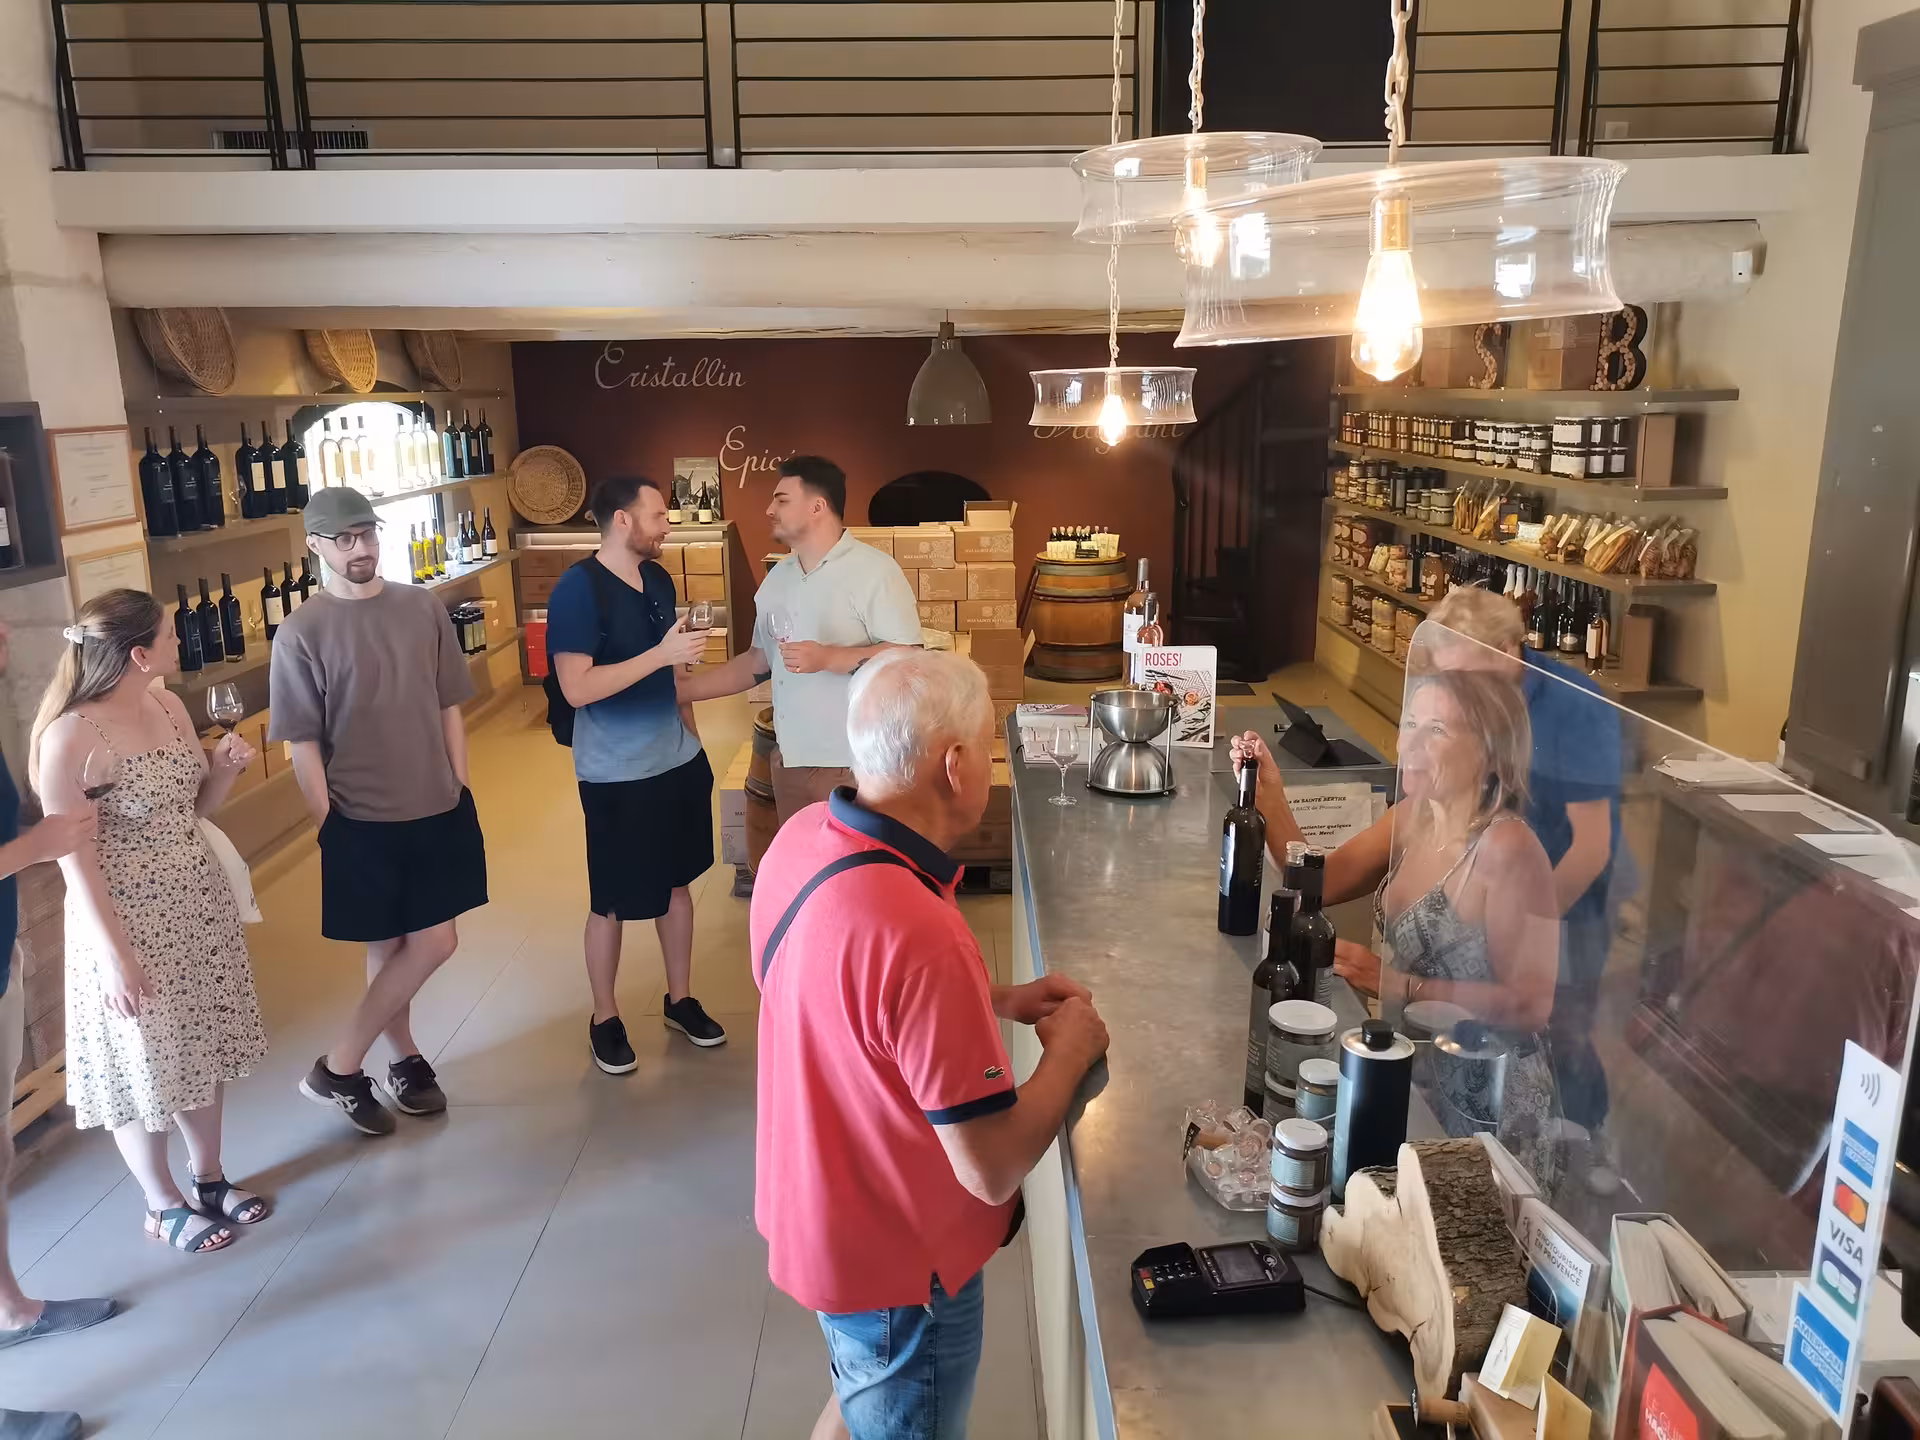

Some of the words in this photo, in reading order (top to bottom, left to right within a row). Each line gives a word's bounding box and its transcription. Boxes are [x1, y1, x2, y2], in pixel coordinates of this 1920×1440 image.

[595, 340, 746, 389] Cristallin
[1145, 652, 1182, 667] ROSES!
[1828, 1218, 1864, 1266] VISA
[1543, 1247, 1581, 1287] PROVENCE
[1794, 1315, 1844, 1376] AMERICAN
[1801, 1339, 1843, 1393] EXPRESS
